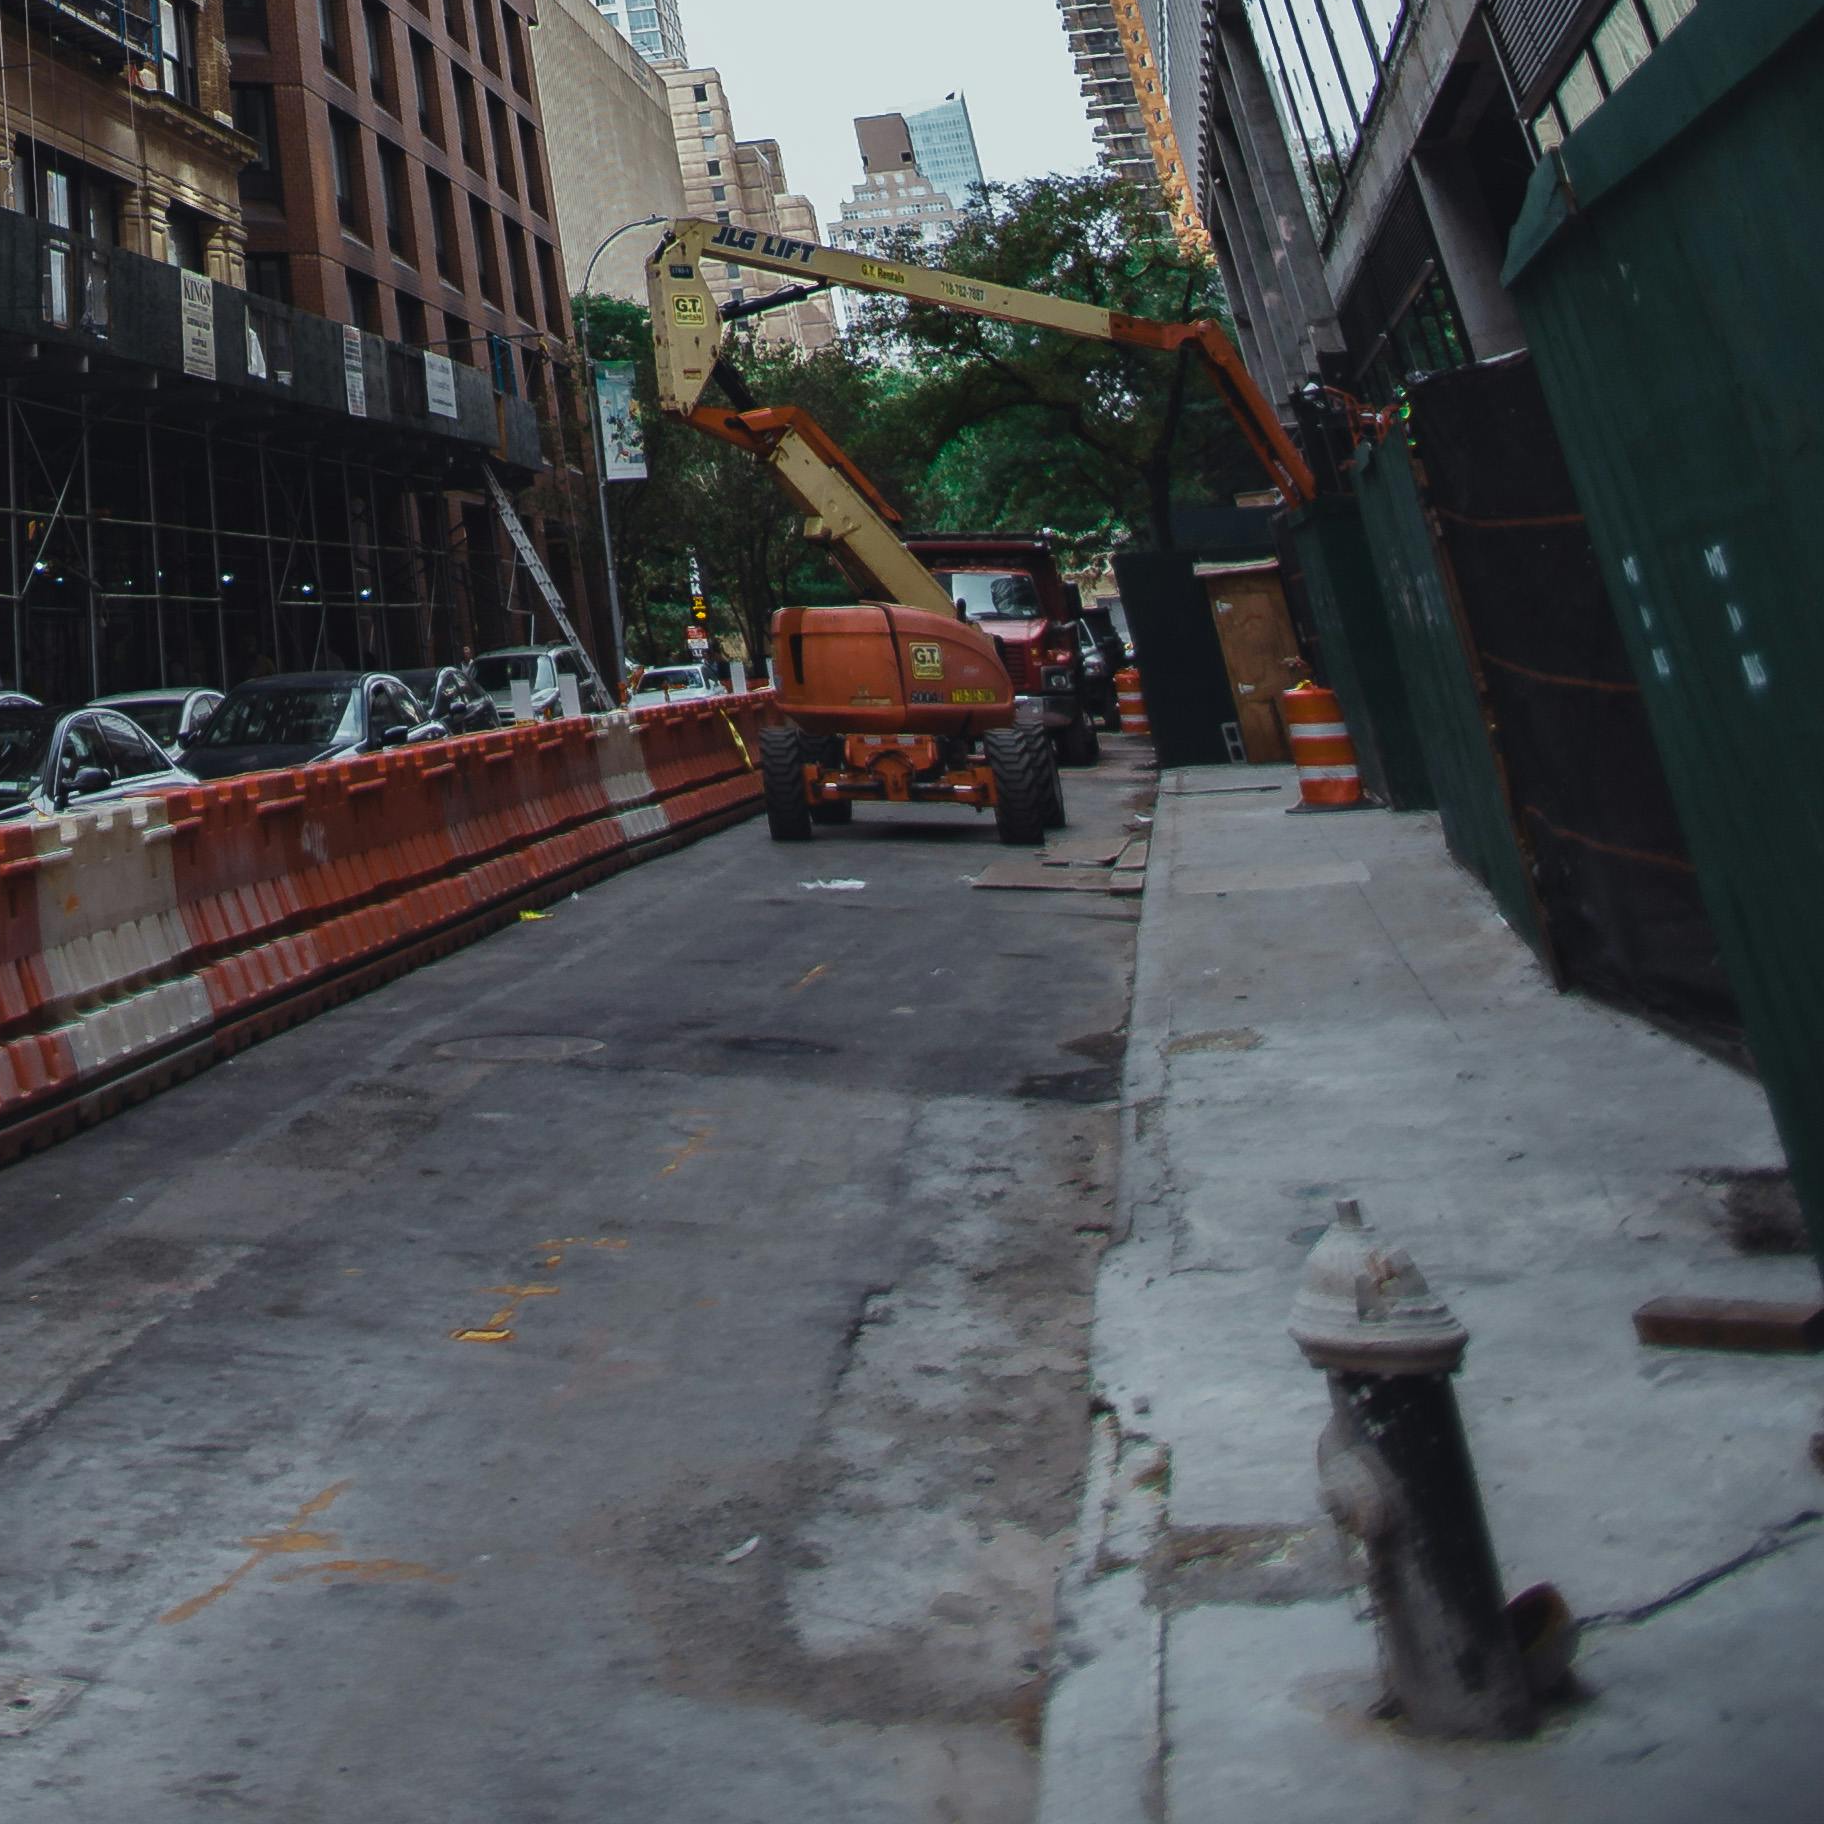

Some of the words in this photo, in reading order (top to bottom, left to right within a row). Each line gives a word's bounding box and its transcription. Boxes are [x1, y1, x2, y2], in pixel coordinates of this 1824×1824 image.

[710, 225, 758, 251] JLG
[760, 234, 817, 264] LIFT
[182, 276, 212, 307] KINGS
[675, 297, 702, 313] G.T.
[914, 647, 940, 665] G.T.
